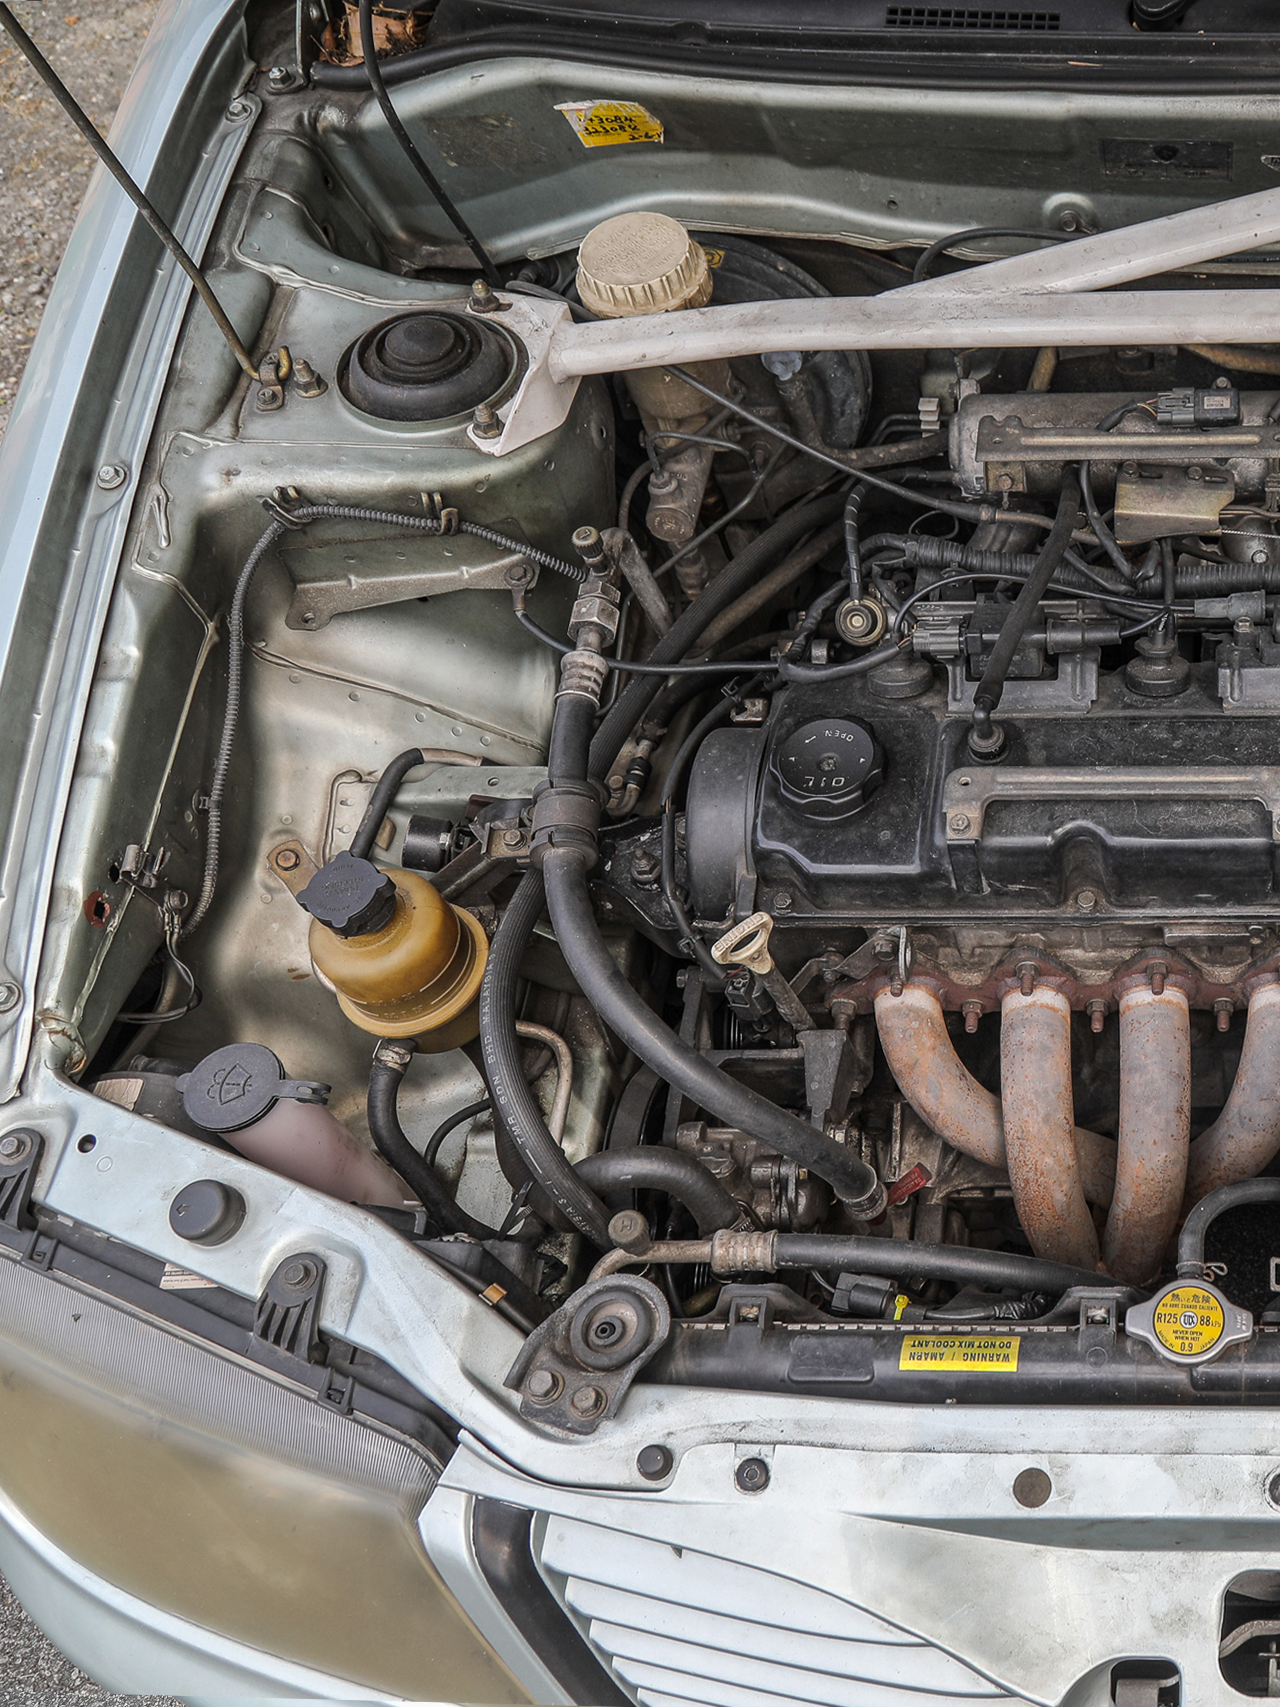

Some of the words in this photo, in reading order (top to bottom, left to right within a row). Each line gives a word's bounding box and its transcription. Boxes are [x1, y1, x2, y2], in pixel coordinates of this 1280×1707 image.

[824, 730, 854, 742] OPEN
[804, 776, 845, 787] OIL
[1157, 1312, 1178, 1324] R125
[1180, 1342, 1193, 1352] 0.9
[1200, 1337, 1215, 1350] JAPAN
[963, 1353, 1010, 1362] WARNING
